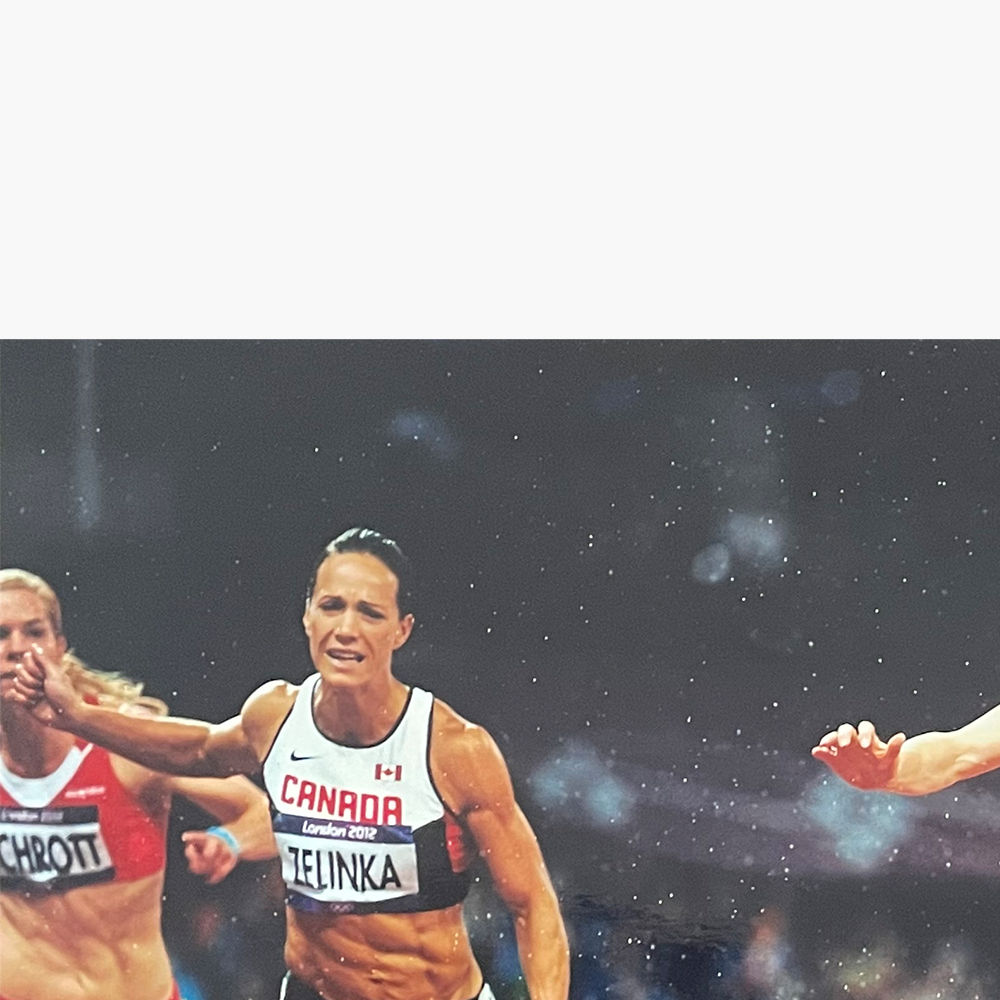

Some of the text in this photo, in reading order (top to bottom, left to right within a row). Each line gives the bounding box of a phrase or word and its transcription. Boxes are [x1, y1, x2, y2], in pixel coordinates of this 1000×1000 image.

[280, 774, 403, 826] CANADA
[302, 820, 378, 840] London 2012
[287, 846, 402, 892] ZELINKA
